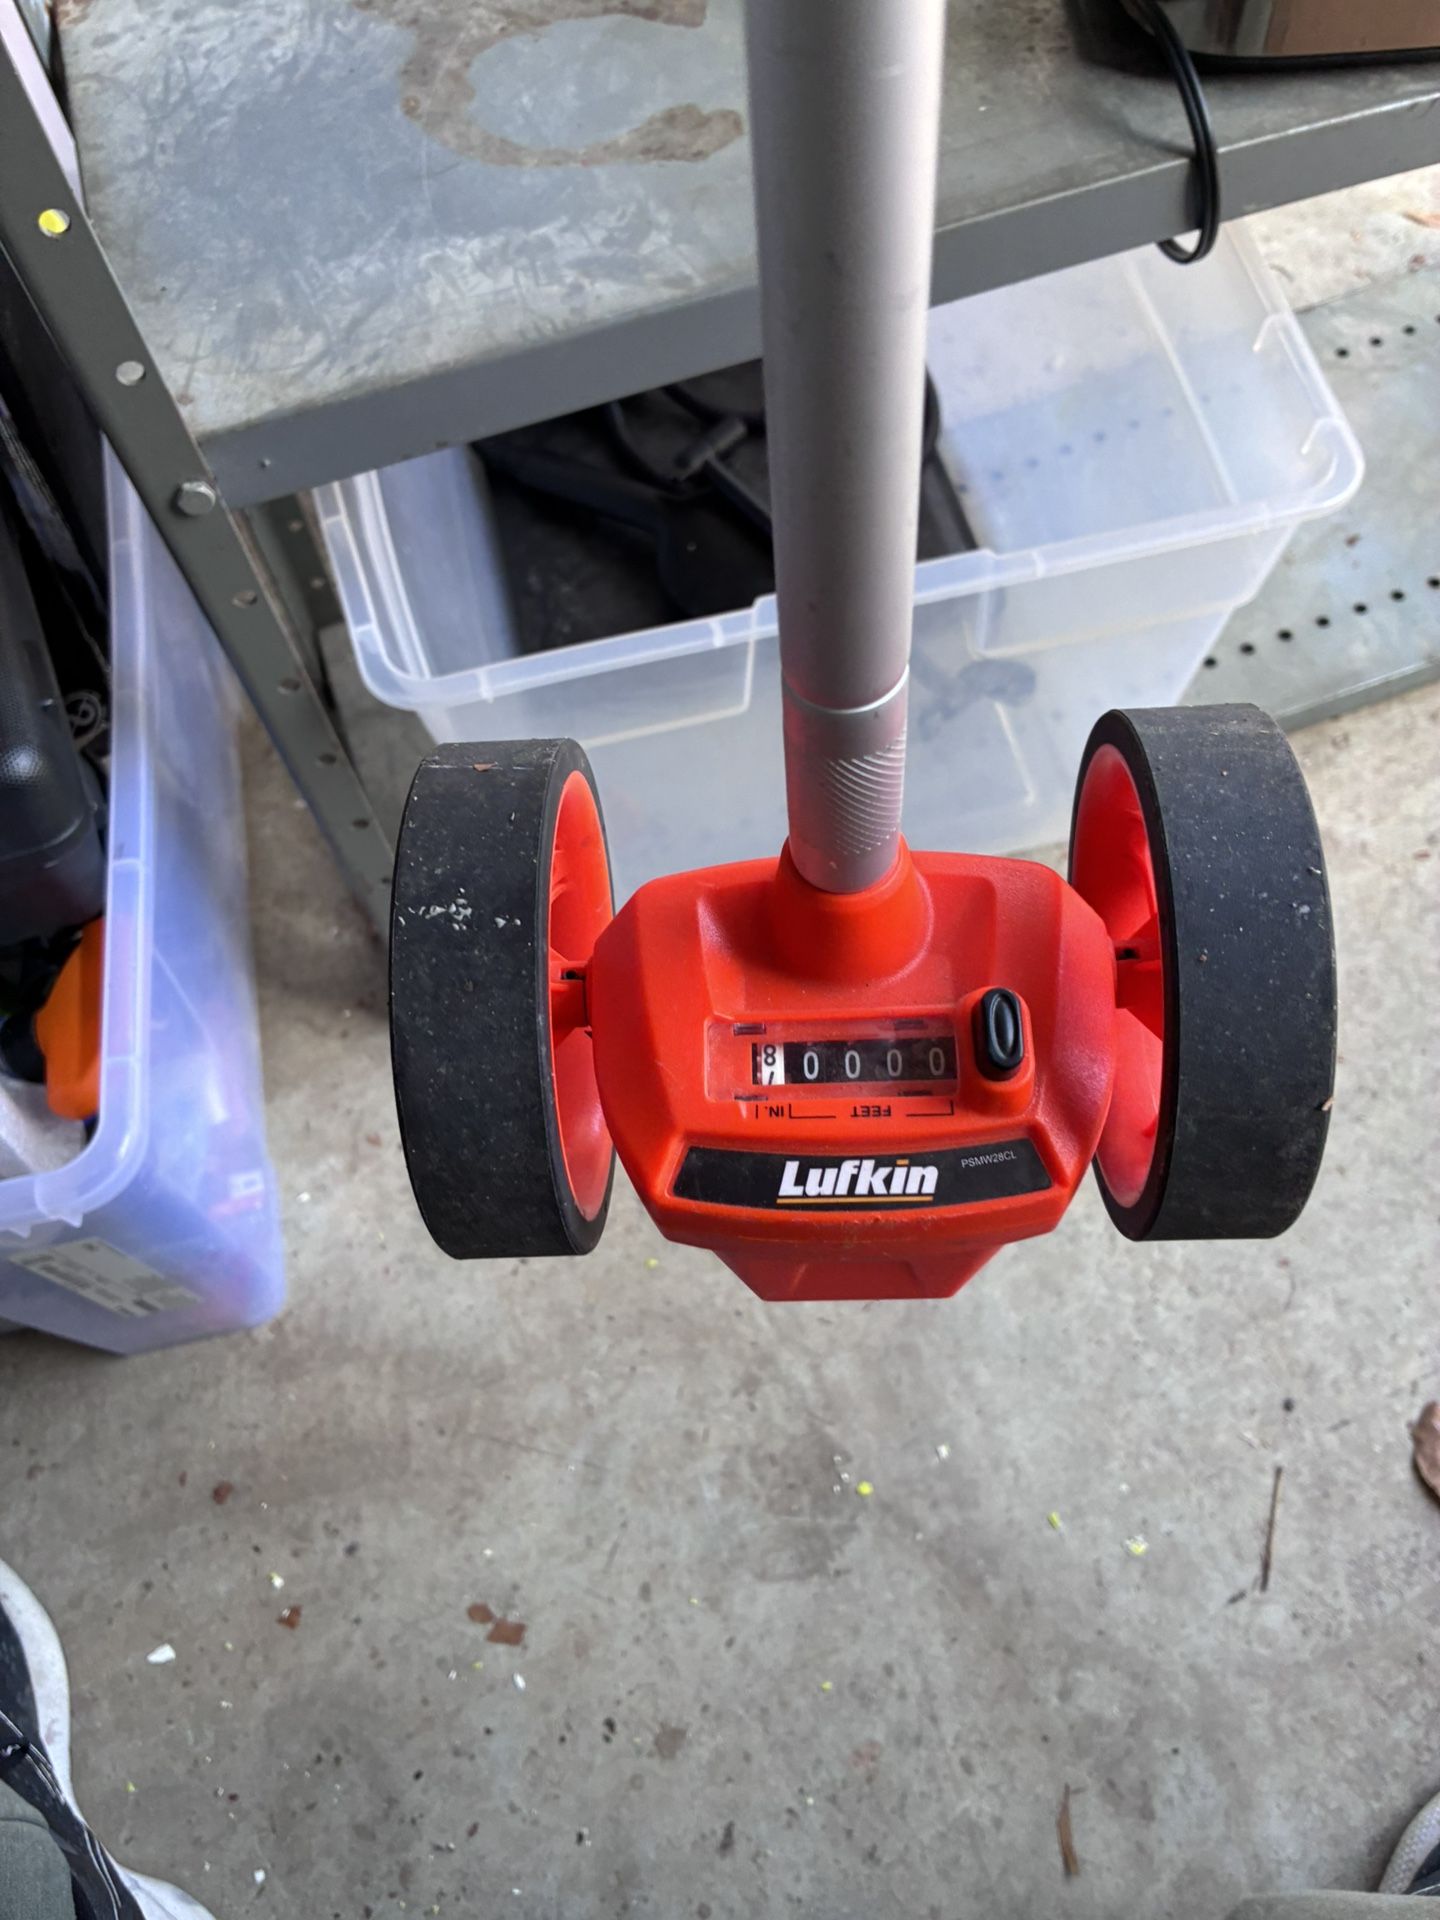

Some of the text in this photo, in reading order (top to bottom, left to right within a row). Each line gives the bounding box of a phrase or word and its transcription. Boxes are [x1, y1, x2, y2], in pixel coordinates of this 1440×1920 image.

[851, 1104, 892, 1117] FEET
[960, 1150, 1018, 1168] PSMW28CL
[777, 1159, 939, 1197] Lufkin
